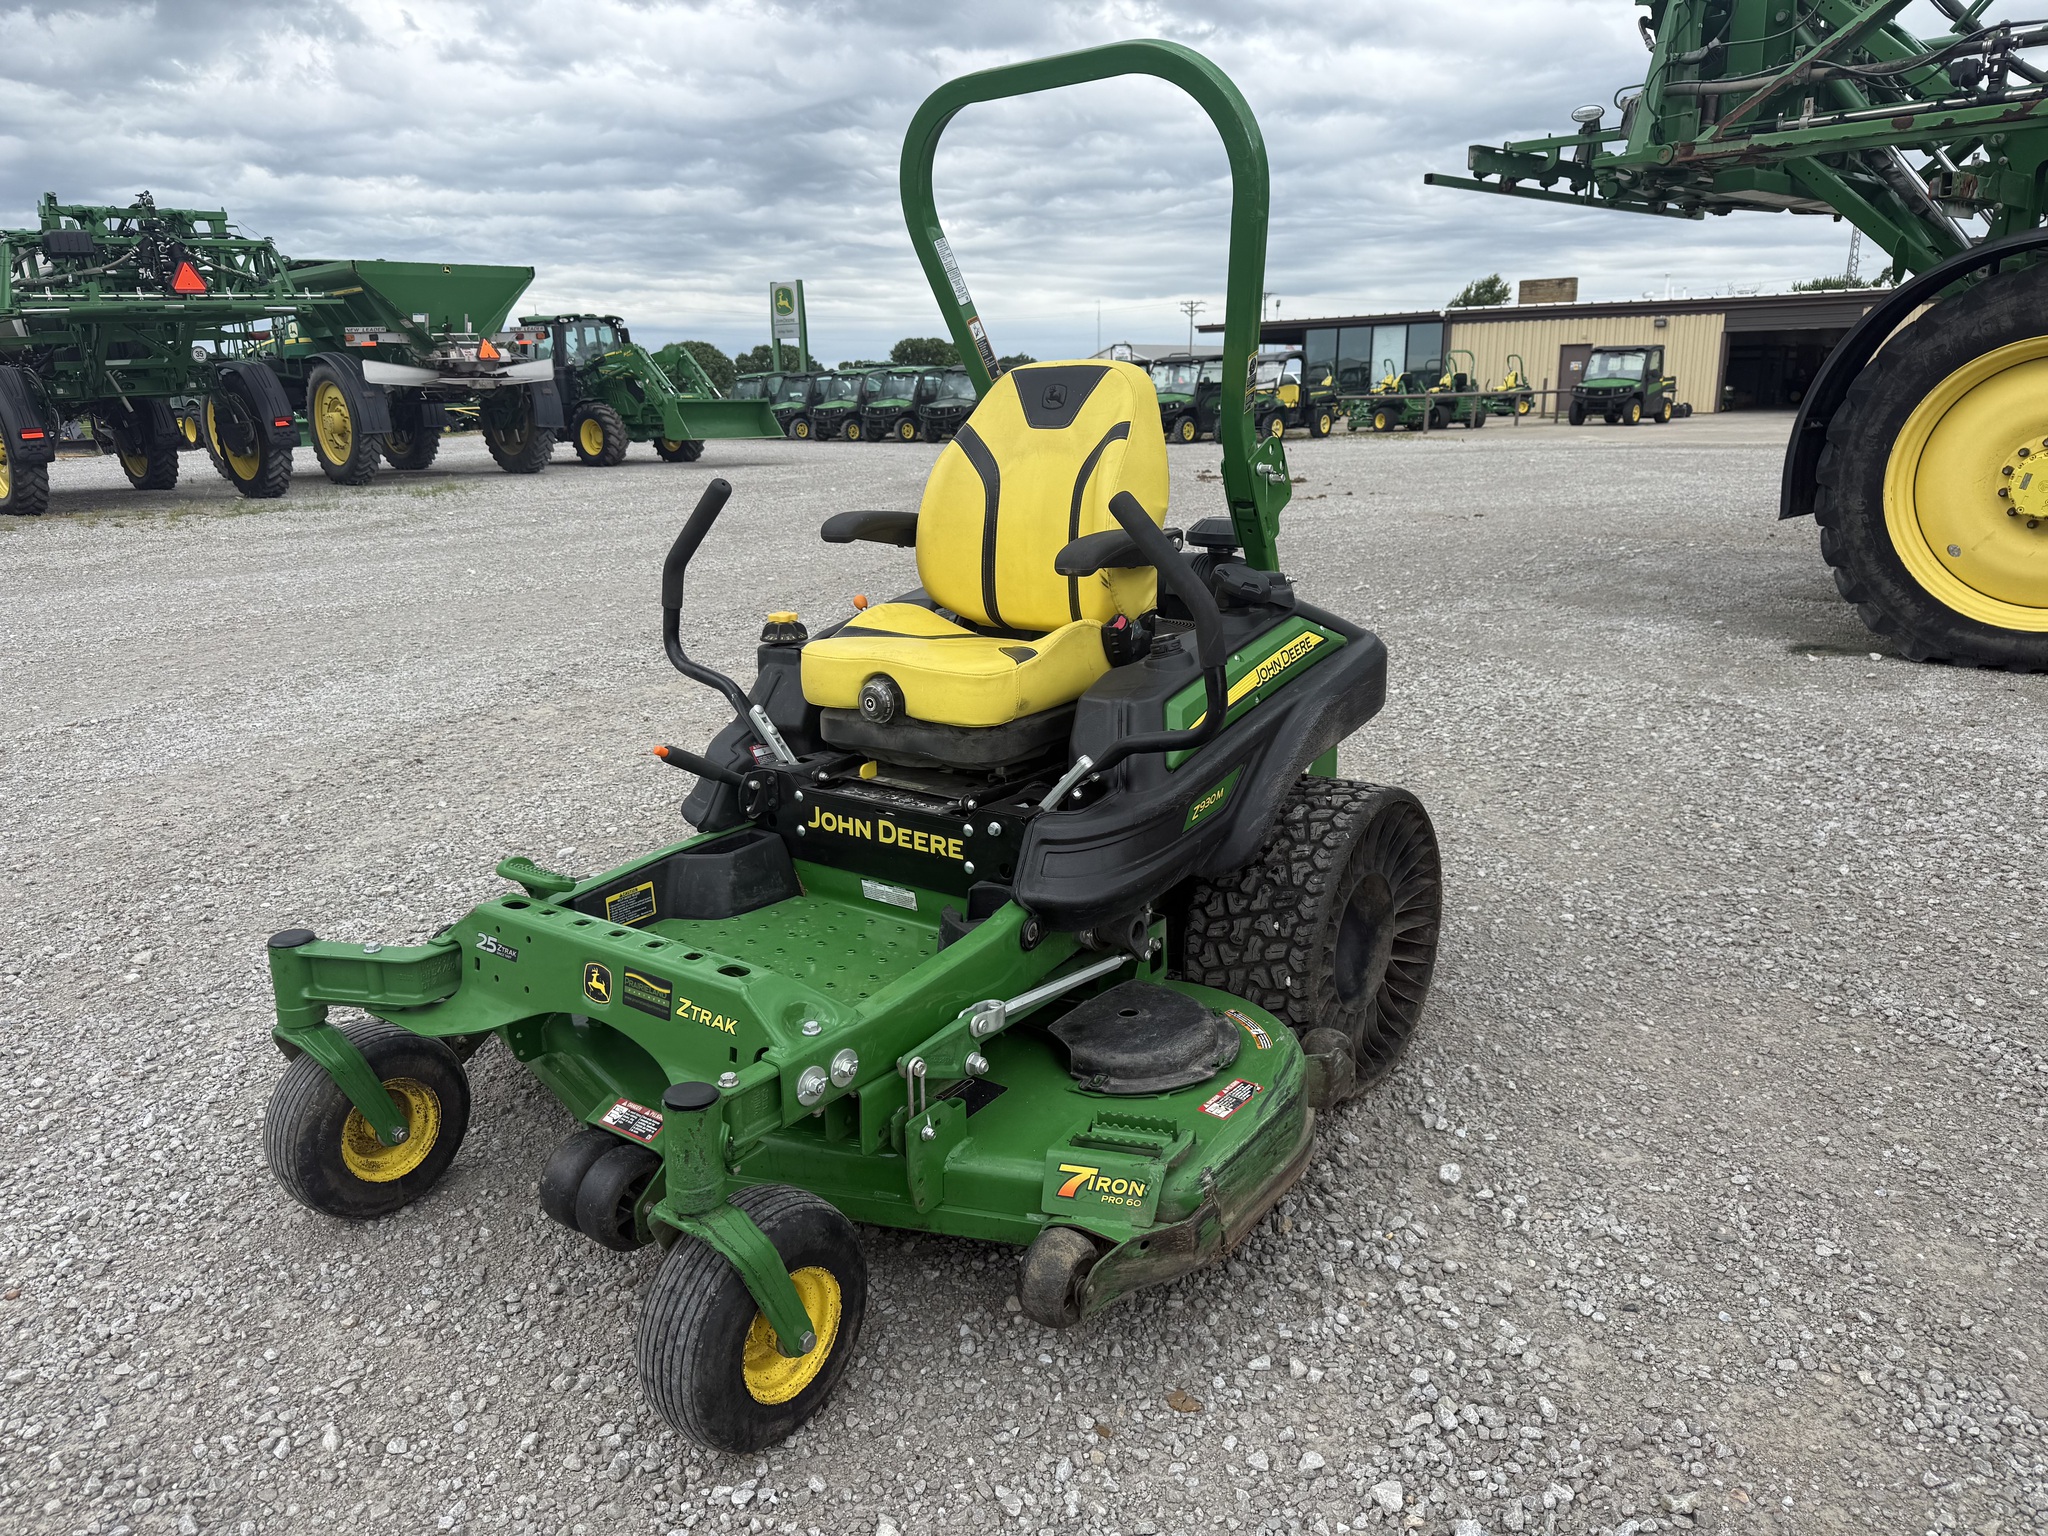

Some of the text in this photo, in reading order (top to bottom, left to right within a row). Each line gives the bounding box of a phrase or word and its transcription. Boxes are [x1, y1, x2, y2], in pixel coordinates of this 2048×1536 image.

[195, 350, 204, 358] 35
[1256, 637, 1313, 685] JOHN DEERE
[1191, 787, 1225, 821] Z930M
[808, 806, 964, 860] JOHN DEERE
[476, 932, 518, 958] 25 ZTRAK
[625, 977, 668, 999] PRAIRIELAND
[675, 997, 740, 1036] ZTRAK
[1101, 1195, 1142, 1207] PRO 60
